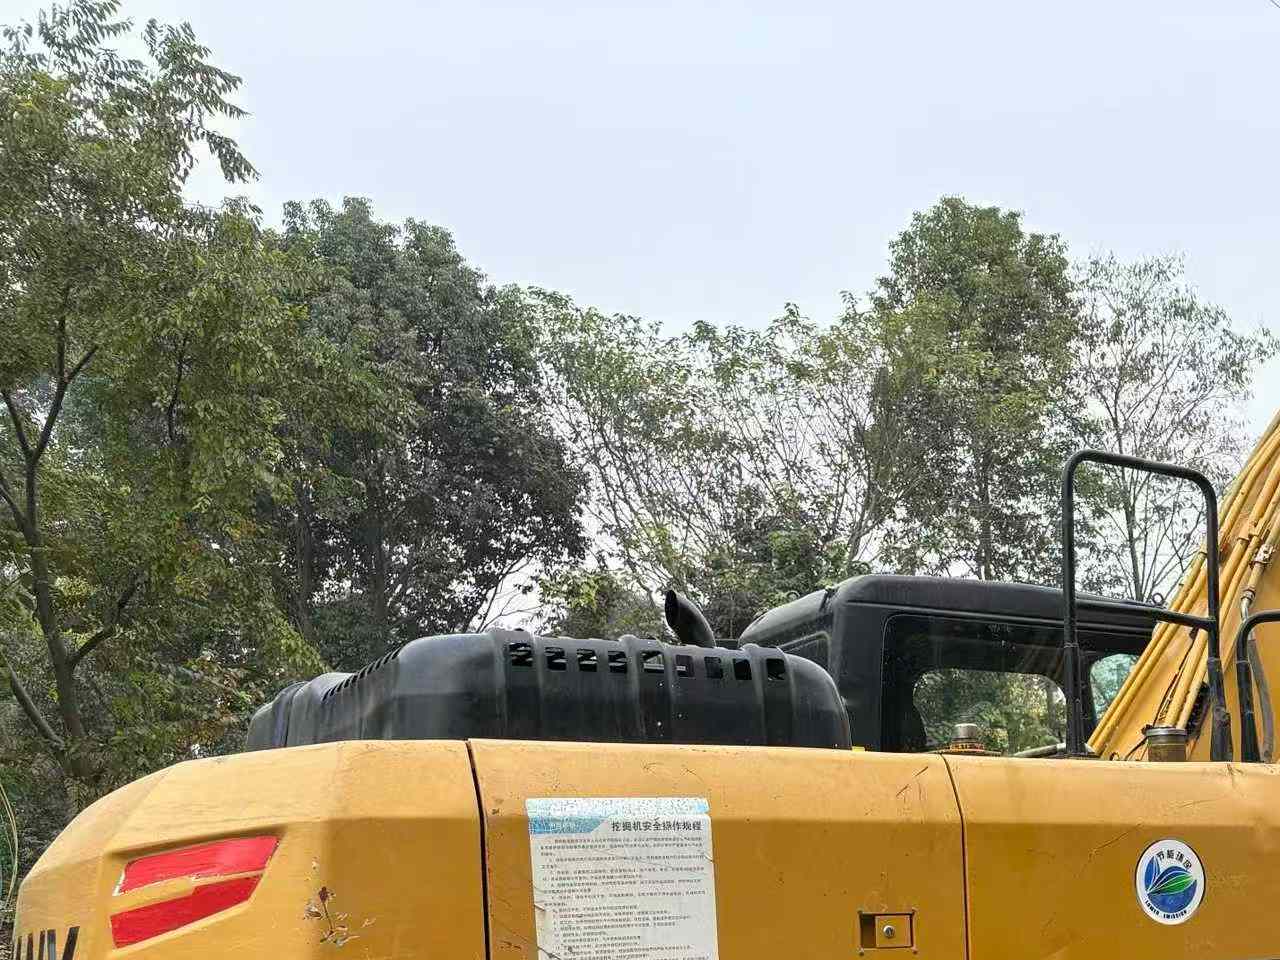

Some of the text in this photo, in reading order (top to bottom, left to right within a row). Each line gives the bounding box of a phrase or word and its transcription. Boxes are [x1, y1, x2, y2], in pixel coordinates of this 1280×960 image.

[611, 820, 703, 832] 挖掘机安全操作规程
